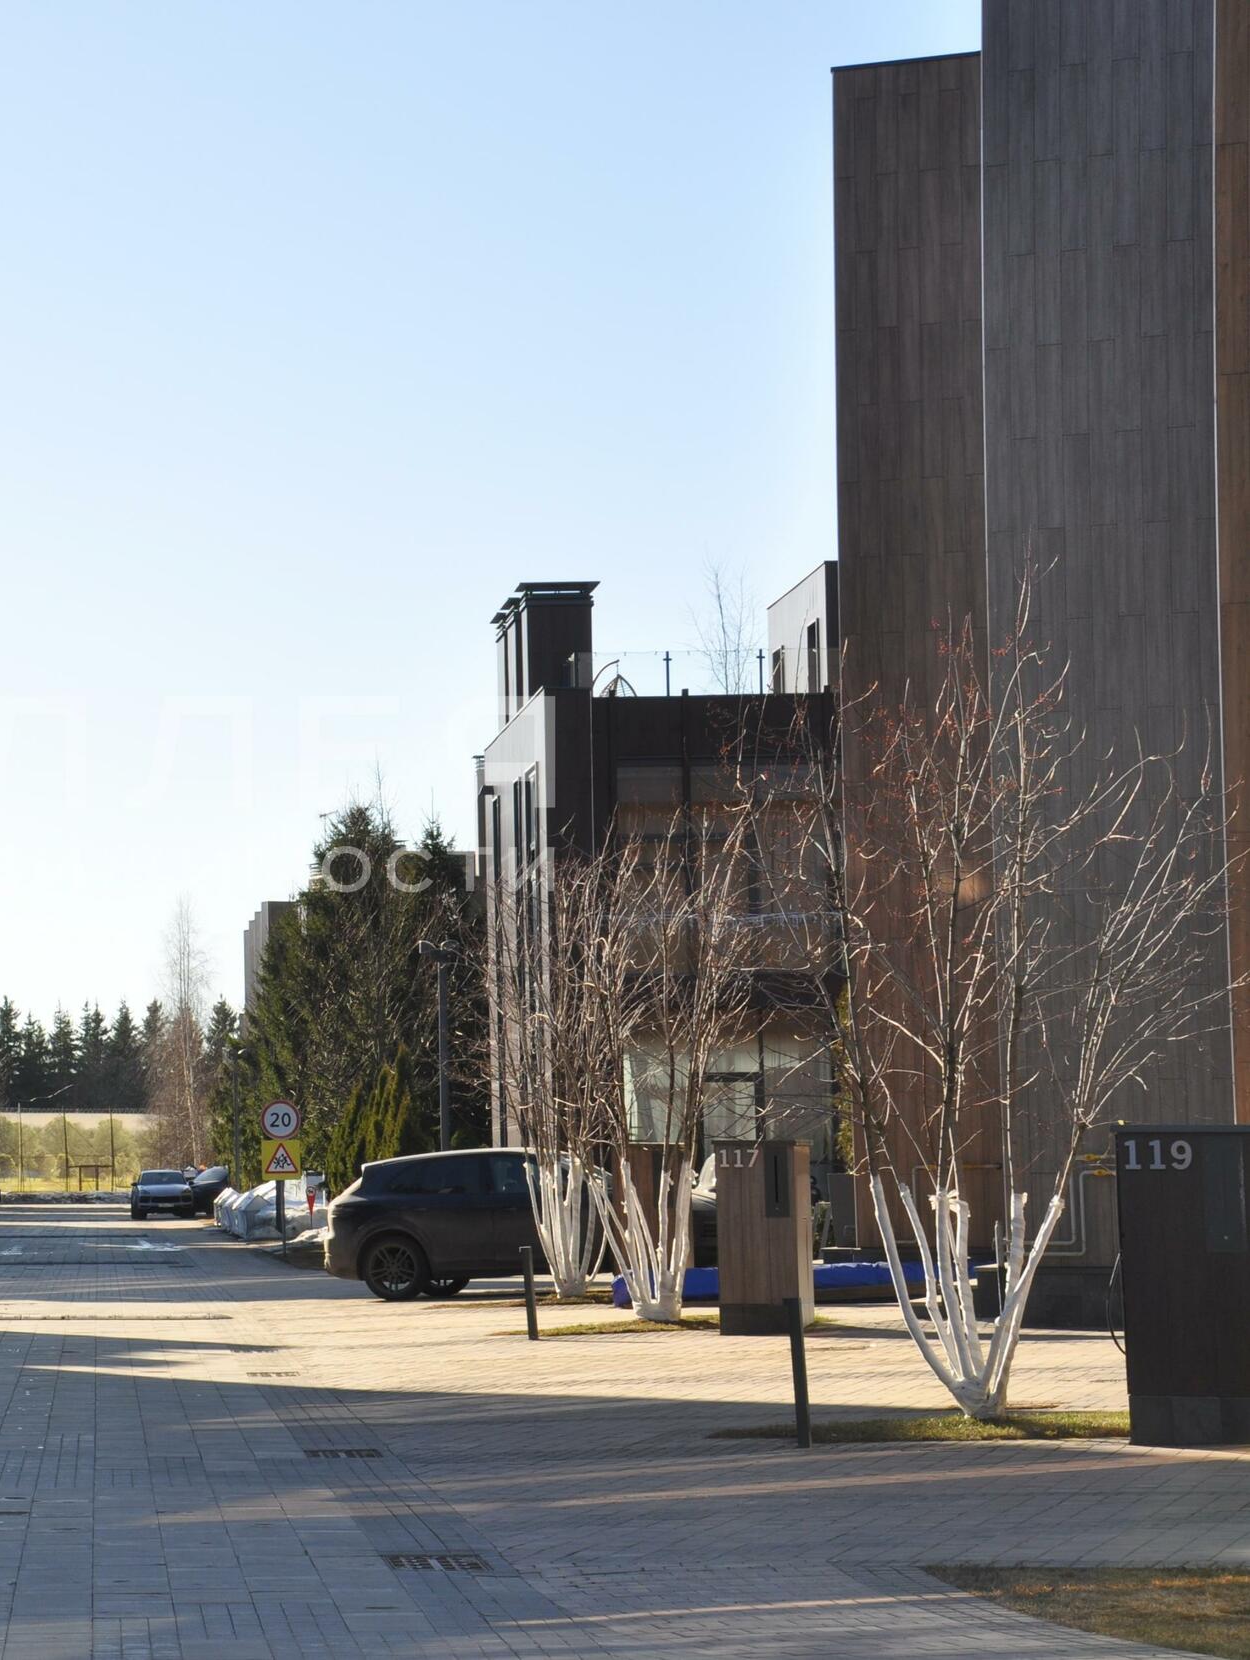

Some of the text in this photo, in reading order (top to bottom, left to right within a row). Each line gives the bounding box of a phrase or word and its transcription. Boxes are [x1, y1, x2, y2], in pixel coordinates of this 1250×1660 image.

[269, 1112, 292, 1128] 20
[719, 1148, 760, 1168] 117
[1124, 1139, 1193, 1170] 119
